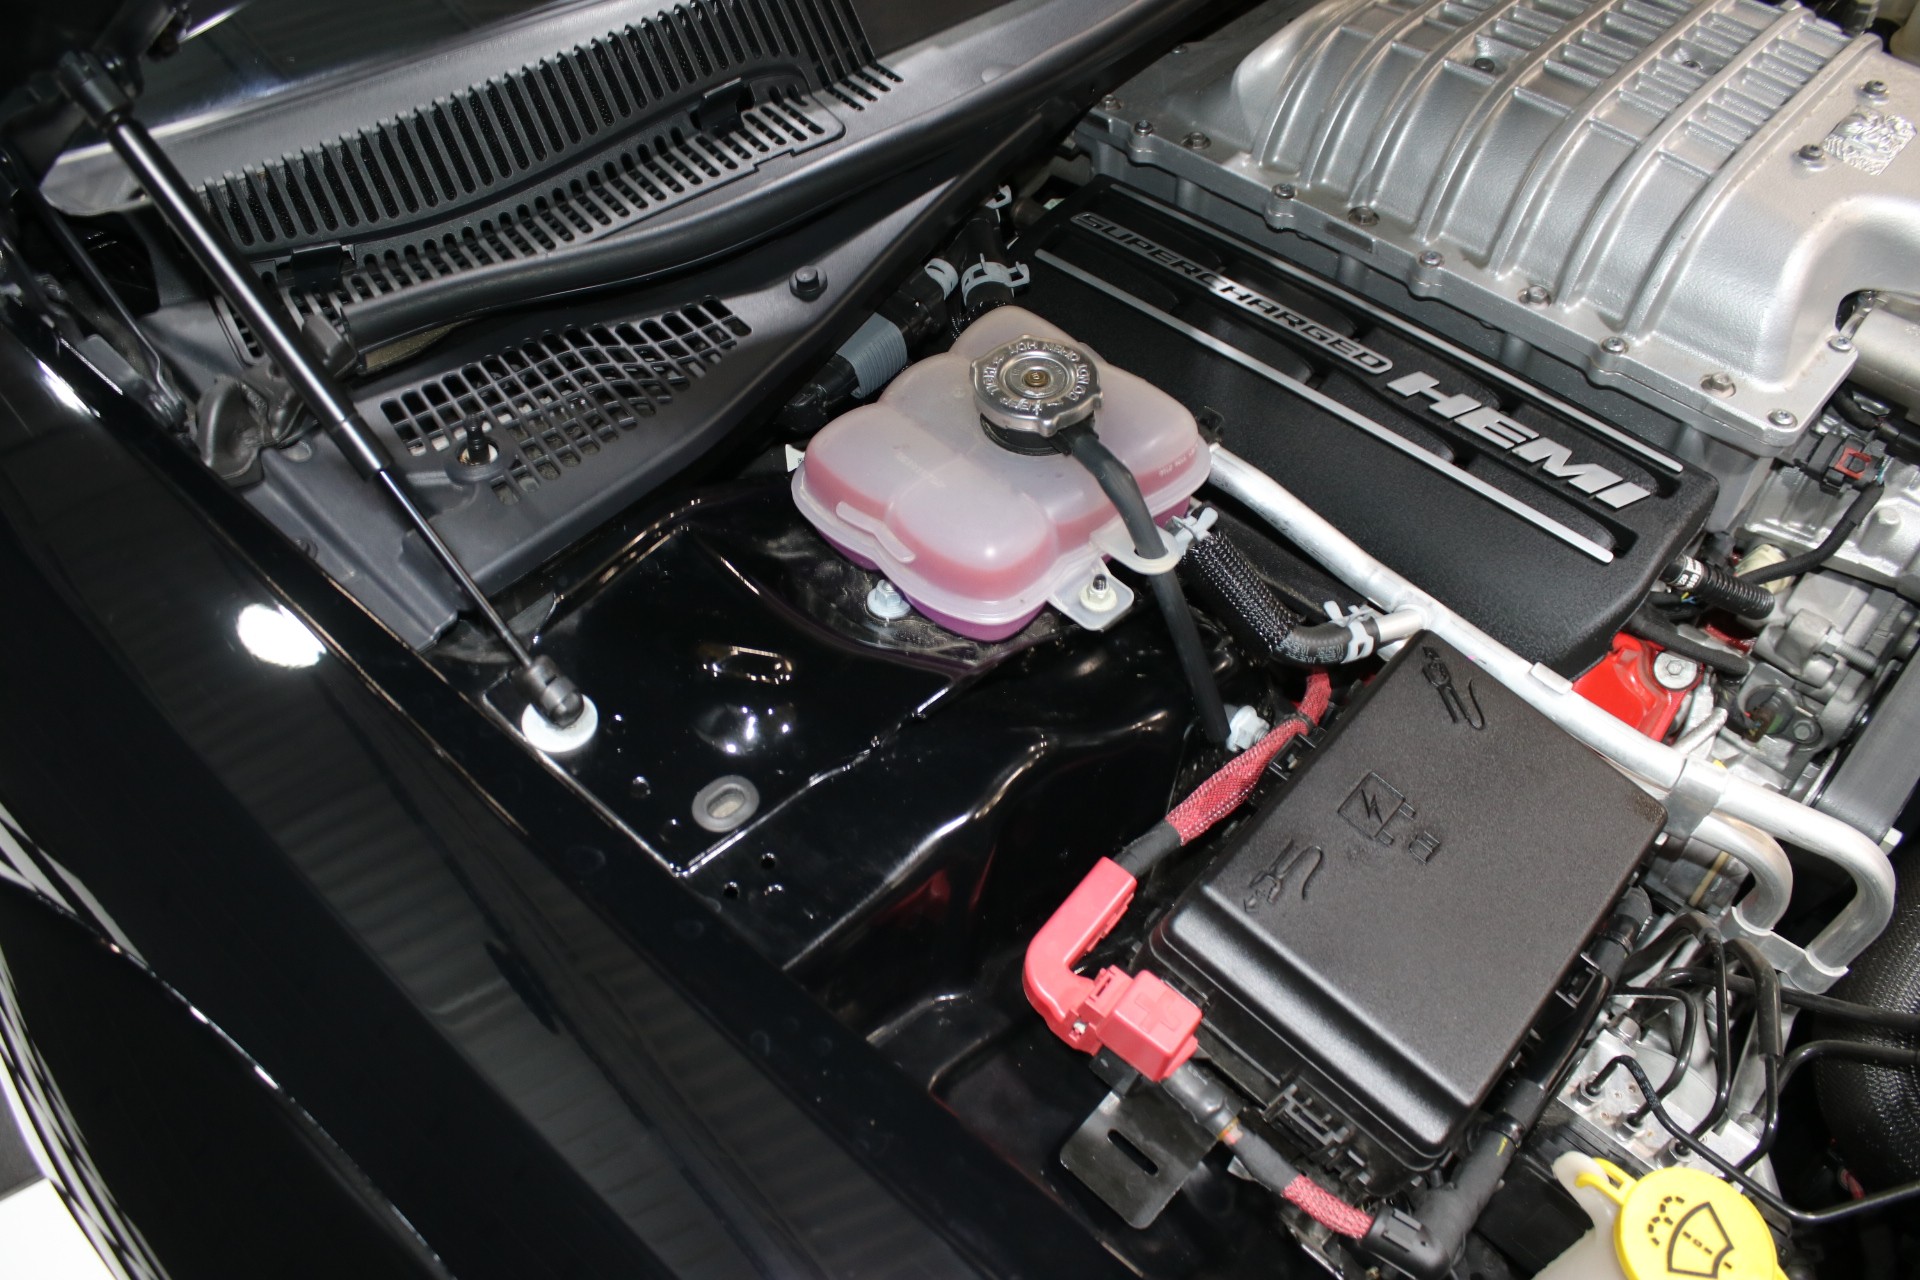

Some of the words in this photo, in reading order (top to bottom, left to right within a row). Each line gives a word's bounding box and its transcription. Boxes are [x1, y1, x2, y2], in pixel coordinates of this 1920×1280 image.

[1067, 385, 1086, 400] DO
[1077, 364, 1090, 385] NOT
[1074, 212, 1388, 369] SUPERCHARGED
[1386, 371, 1651, 509] HEMI
